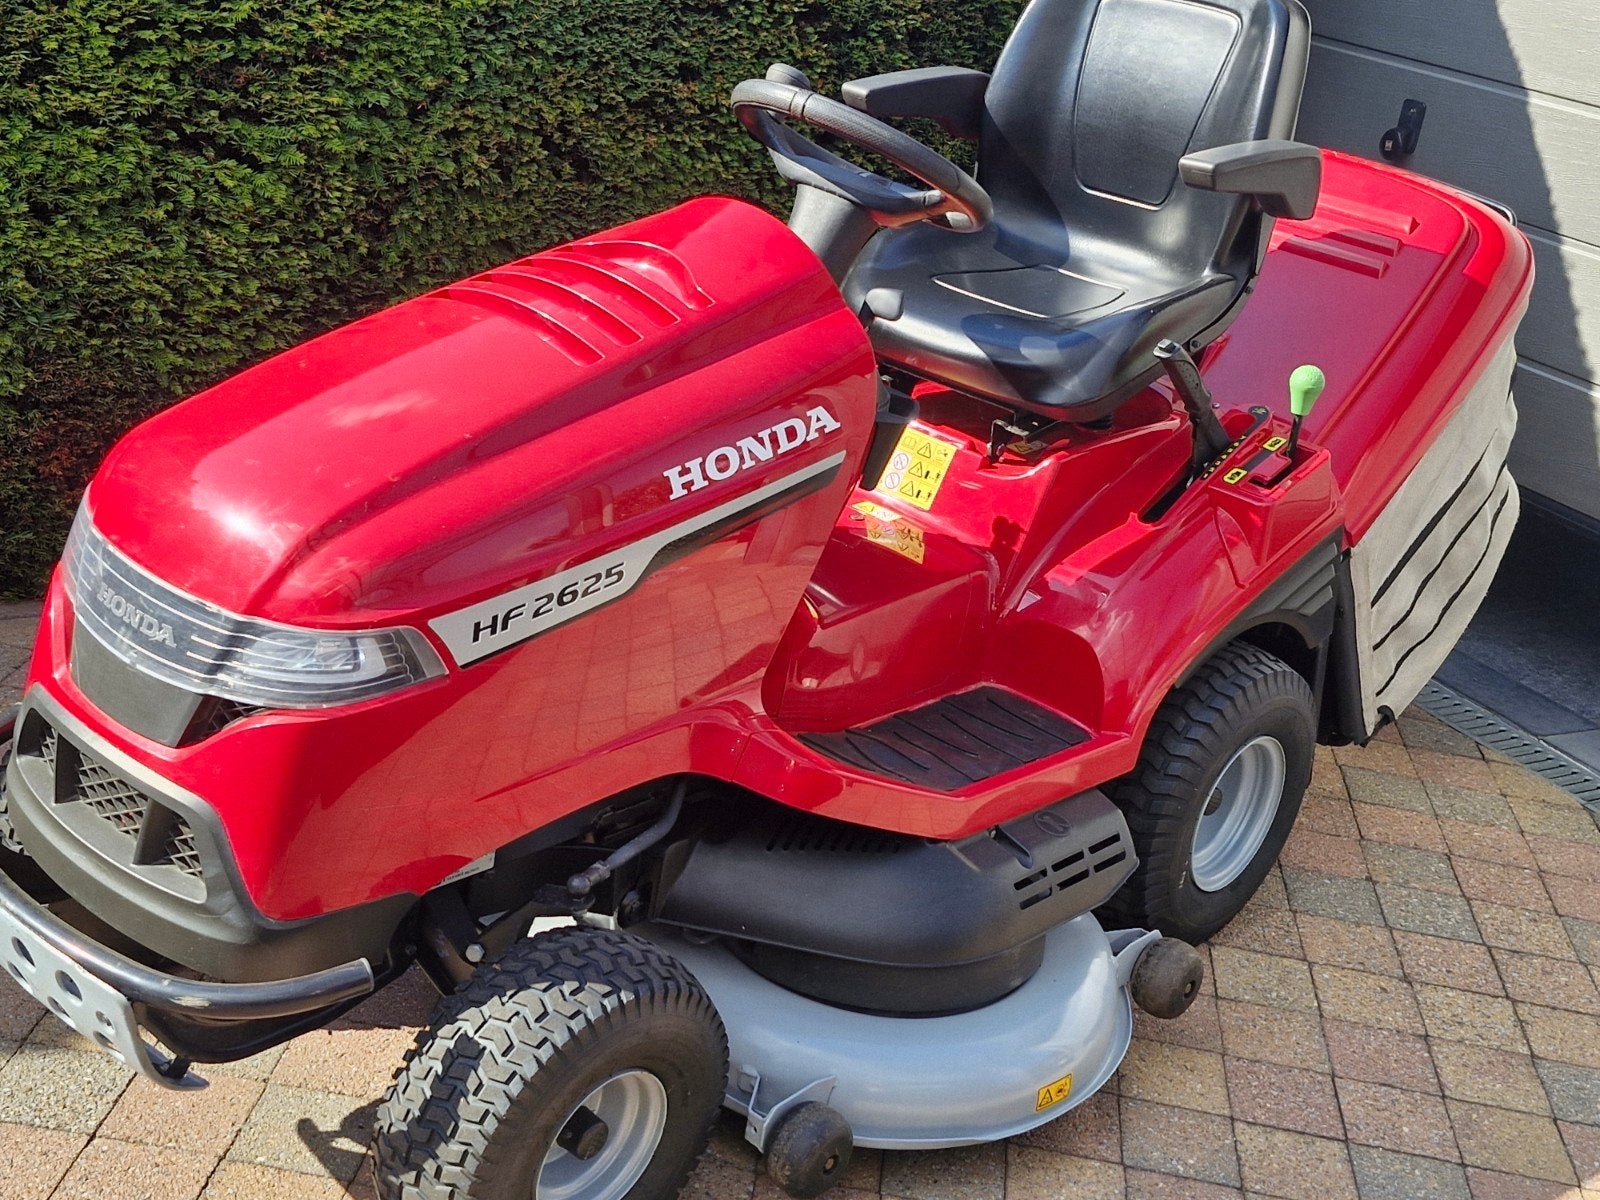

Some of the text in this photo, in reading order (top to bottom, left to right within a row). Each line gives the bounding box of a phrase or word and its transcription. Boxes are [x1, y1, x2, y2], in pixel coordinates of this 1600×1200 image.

[663, 406, 841, 500] HONDA
[97, 582, 177, 648] HONDA
[472, 562, 625, 643] HF 2625
